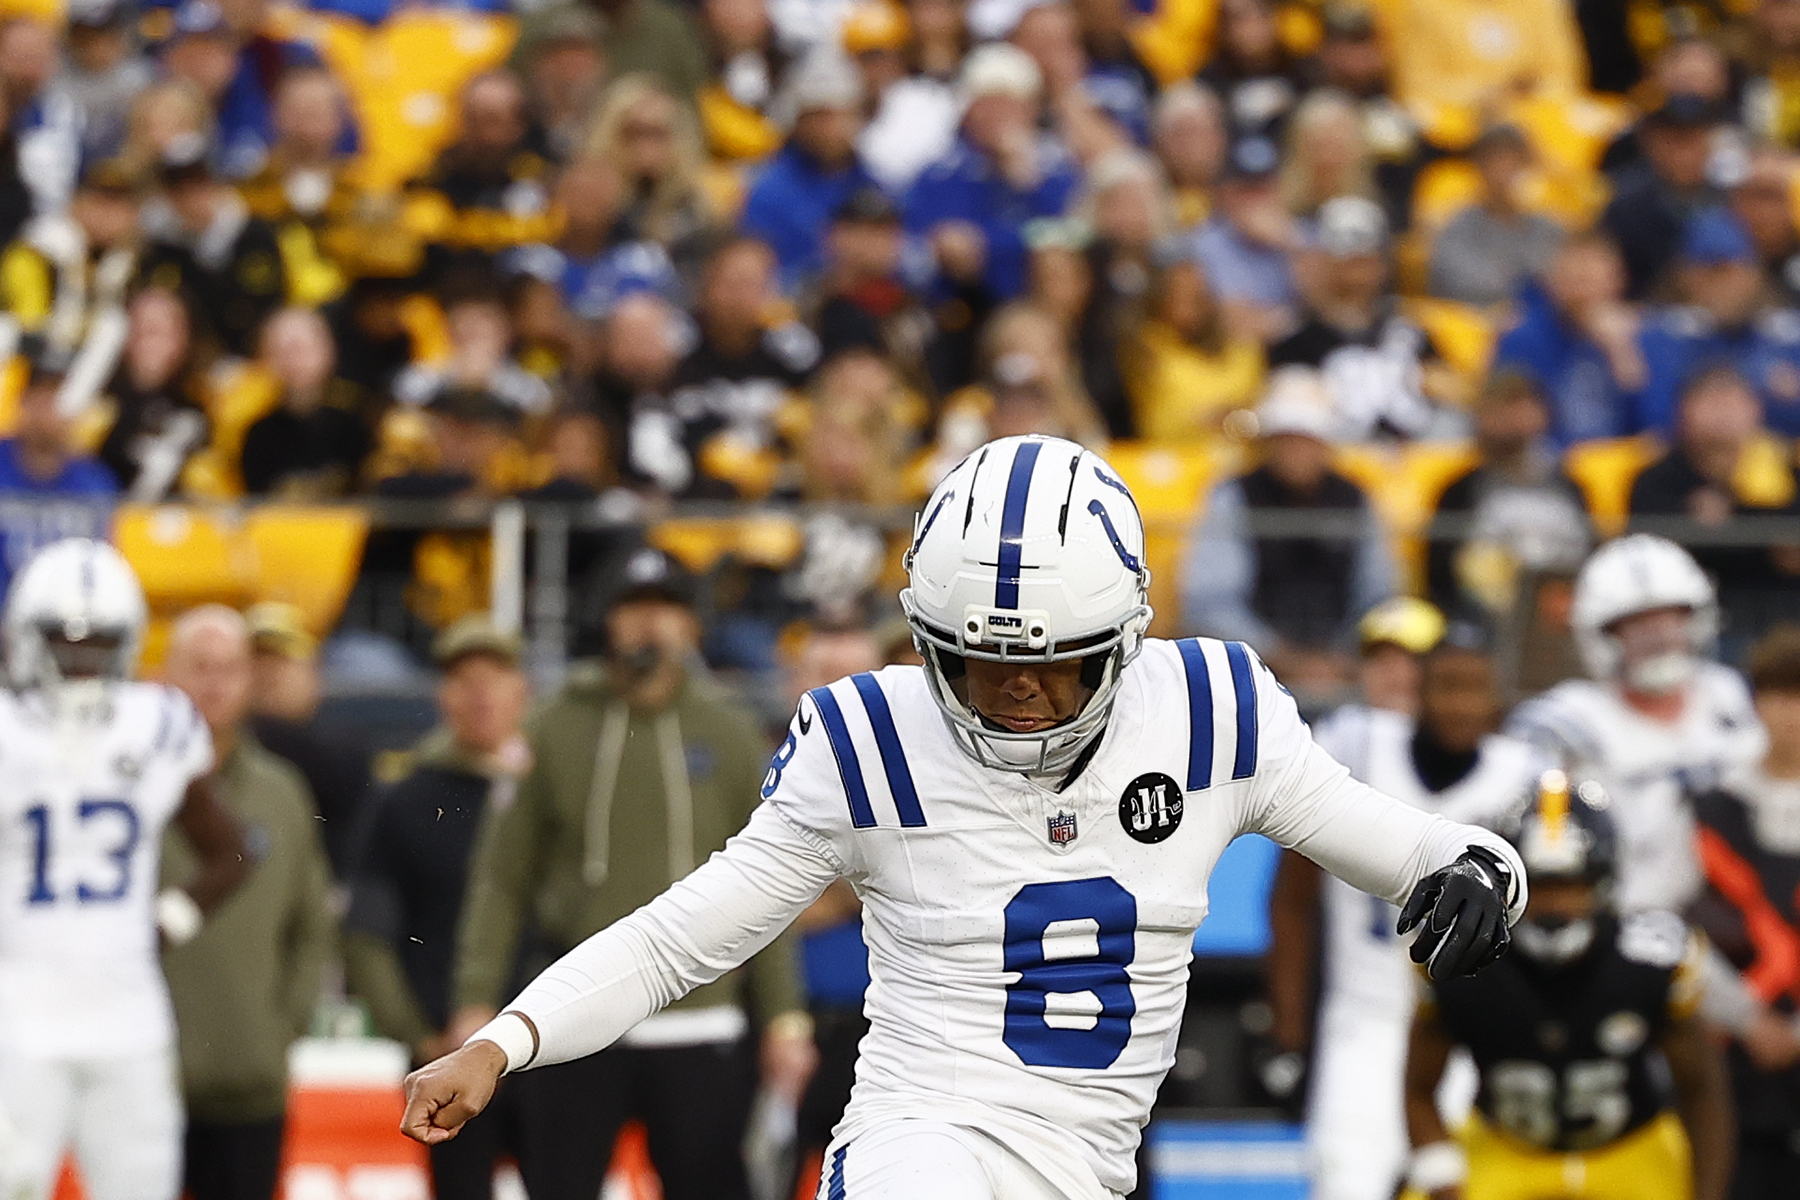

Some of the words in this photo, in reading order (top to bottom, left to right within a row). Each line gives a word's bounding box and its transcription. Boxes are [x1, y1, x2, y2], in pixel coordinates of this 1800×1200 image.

[987, 615, 1022, 628] COLTS
[761, 730, 797, 799] 8
[24, 800, 141, 904] 13
[1052, 825, 1075, 841] NFL
[1001, 875, 1137, 1070] 8
